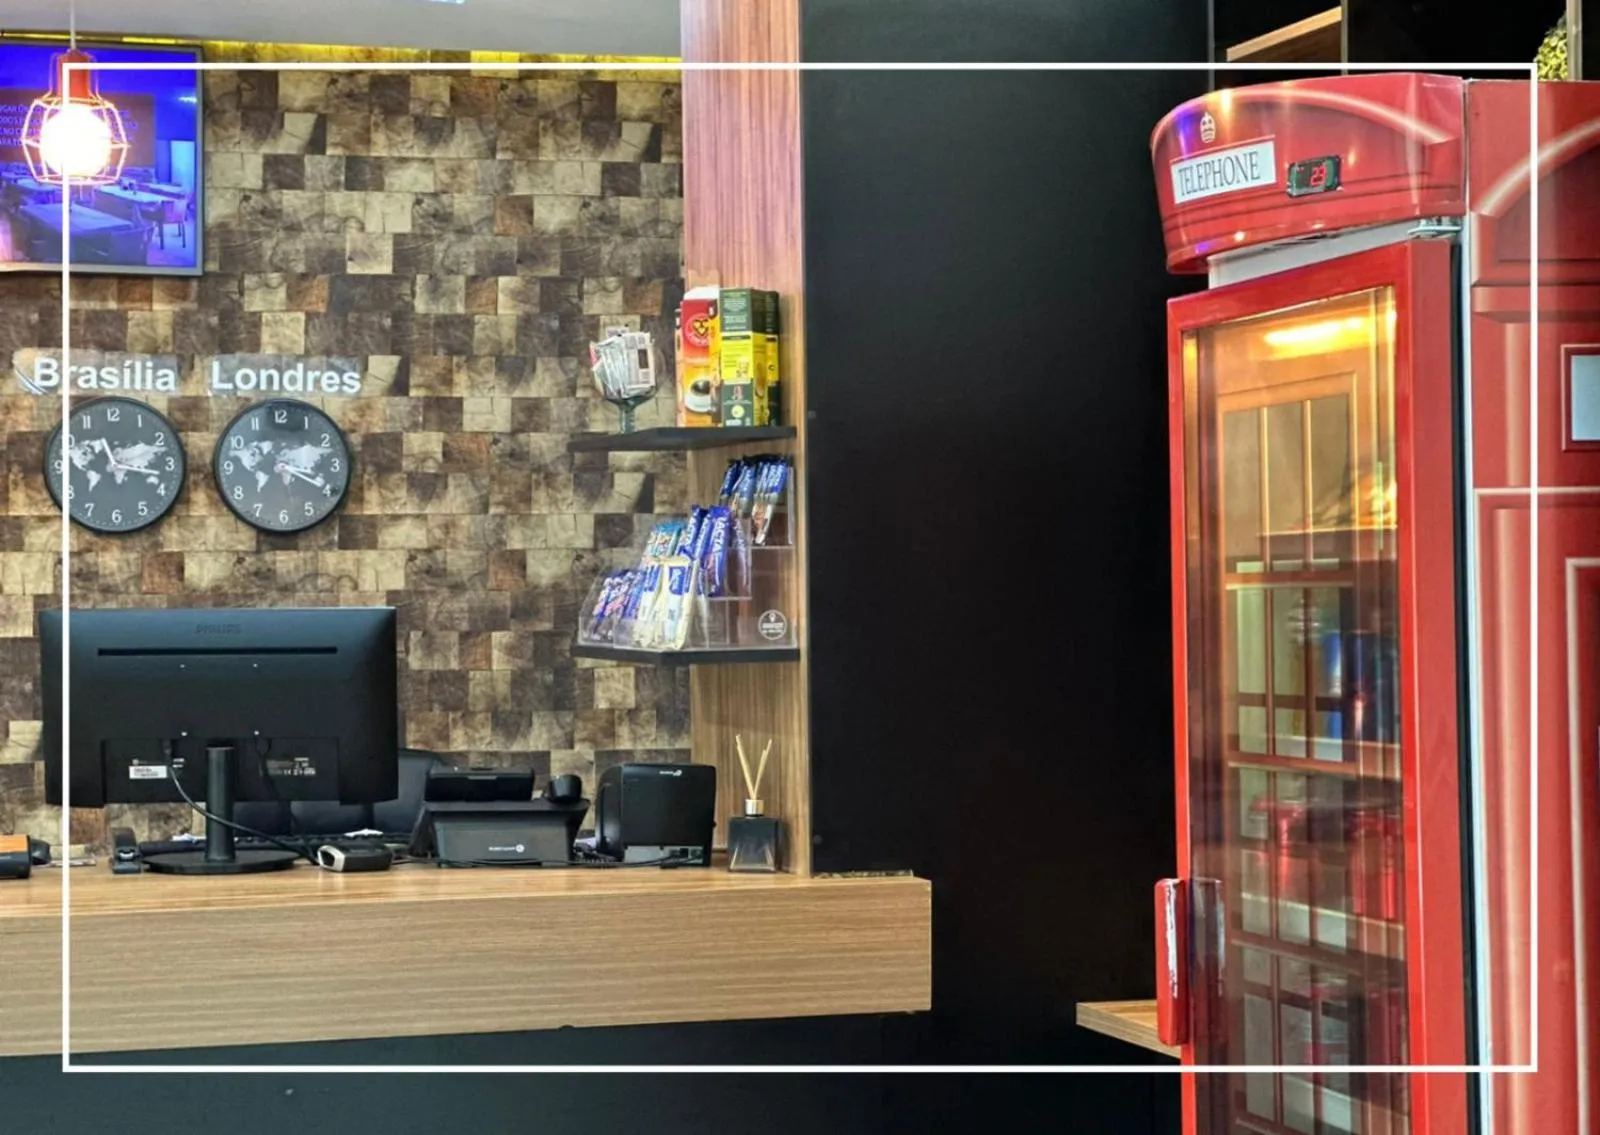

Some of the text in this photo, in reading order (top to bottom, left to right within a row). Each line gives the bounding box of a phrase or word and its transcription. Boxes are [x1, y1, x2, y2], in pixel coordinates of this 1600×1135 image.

[1178, 151, 1261, 196] TELEPHONE
[33, 357, 176, 393] Brasília
[211, 361, 362, 394] Londres
[107, 408, 120, 421] 12
[137, 414, 142, 428] 1
[275, 410, 288, 423] 12
[83, 415, 91, 429] 11
[251, 417, 259, 431] 11
[304, 416, 309, 429] 1
[155, 432, 164, 446] 2
[230, 435, 244, 449] 10
[321, 433, 330, 447] 2
[165, 457, 174, 470] 3
[223, 460, 234, 475] 9
[330, 458, 340, 472] 3
[156, 483, 166, 496] 4
[233, 485, 244, 500] 8
[322, 483, 331, 497] 4
[85, 503, 94, 517] 7
[112, 509, 122, 523] 6
[138, 502, 148, 516] 5
[253, 503, 263, 517] 7
[304, 502, 314, 516] 5
[279, 510, 289, 523] 6
